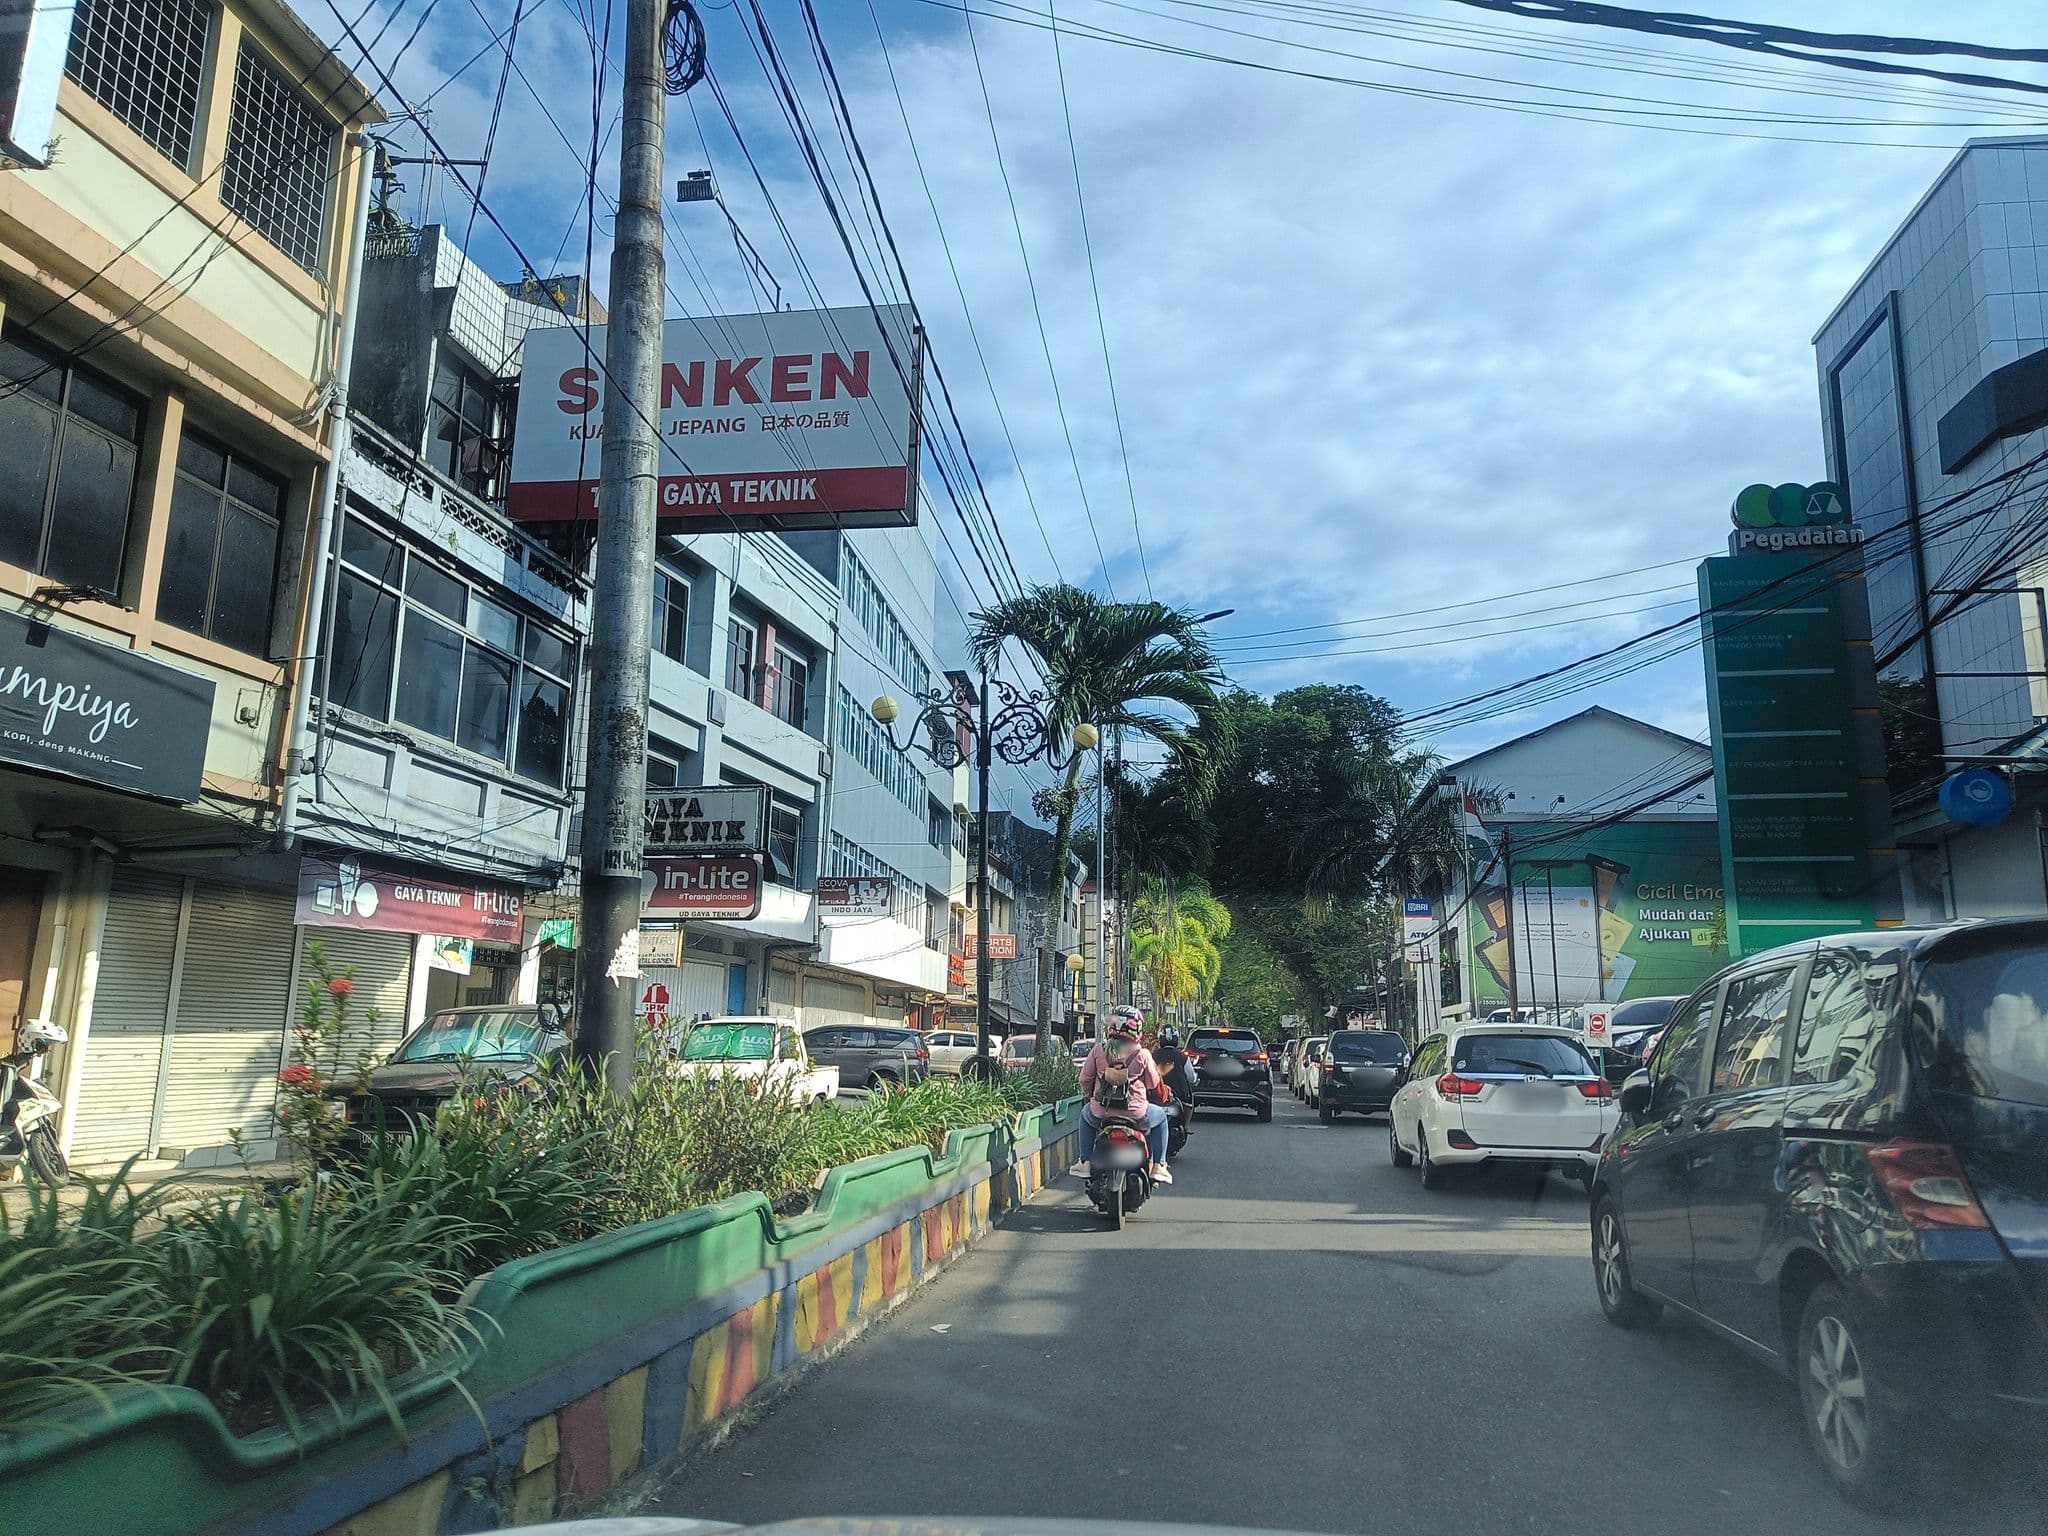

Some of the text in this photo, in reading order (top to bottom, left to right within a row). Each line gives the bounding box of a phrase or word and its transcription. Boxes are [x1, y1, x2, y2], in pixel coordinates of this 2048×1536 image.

[556, 350, 871, 416] SNKEN
[668, 416, 746, 436] JEPANG
[760, 410, 851, 433] 日本の品質
[663, 476, 817, 507] GAYA TEKNIK
[1739, 525, 1865, 552] Pegadaian
[3, 730, 110, 762] KOPI, deng MAKANG
[394, 886, 462, 908] GAYA TEKNIK
[1637, 883, 1676, 900] Cicil
[1639, 909, 1685, 921] Mudah
[1639, 928, 1690, 942] Ajukan
